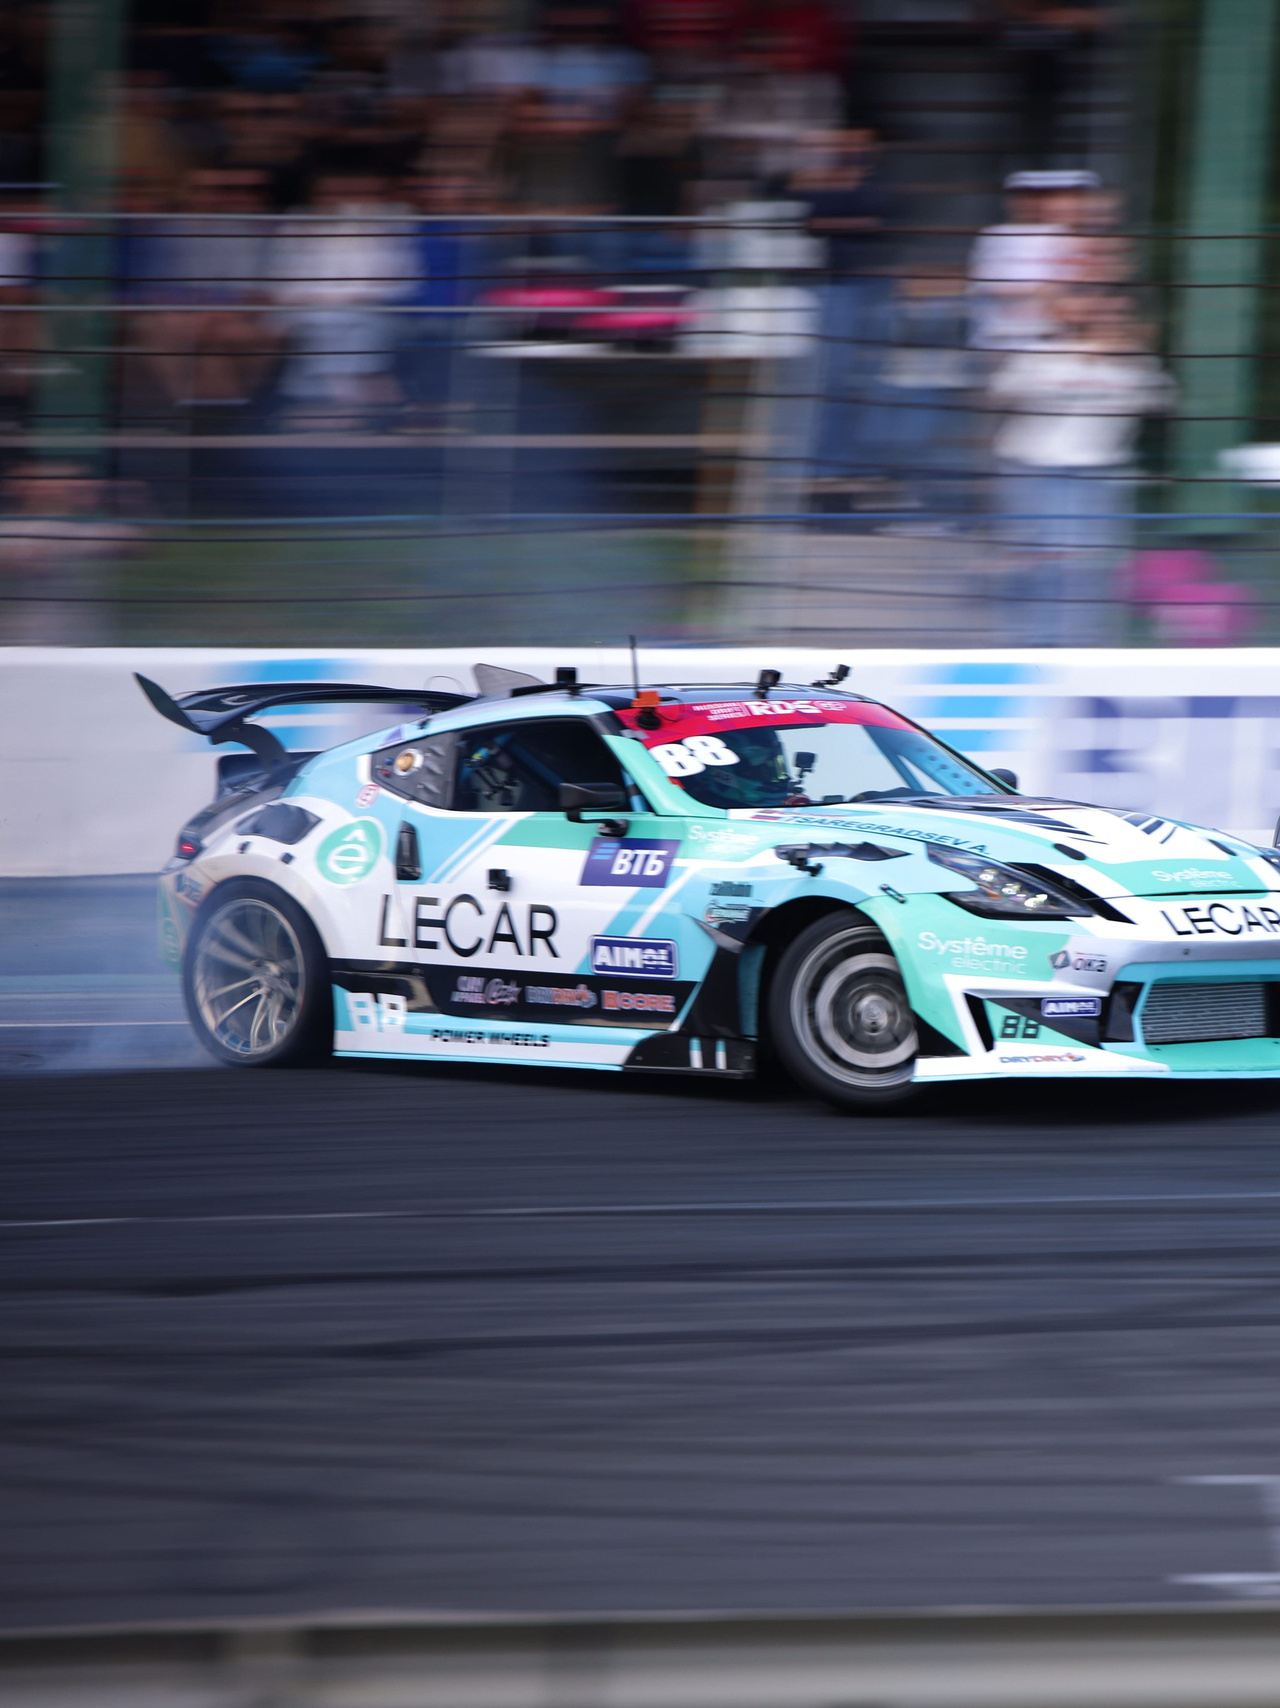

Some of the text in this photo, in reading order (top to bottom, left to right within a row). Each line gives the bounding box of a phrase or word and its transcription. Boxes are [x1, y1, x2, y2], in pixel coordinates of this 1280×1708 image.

[744, 700, 822, 716] RDS
[647, 735, 741, 777] 88
[610, 848, 669, 877] ВТБ
[379, 893, 560, 958] LECAR
[918, 931, 1029, 960] Systême
[951, 957, 1028, 974] electric
[430, 1028, 551, 1048] POWER WHEELS
